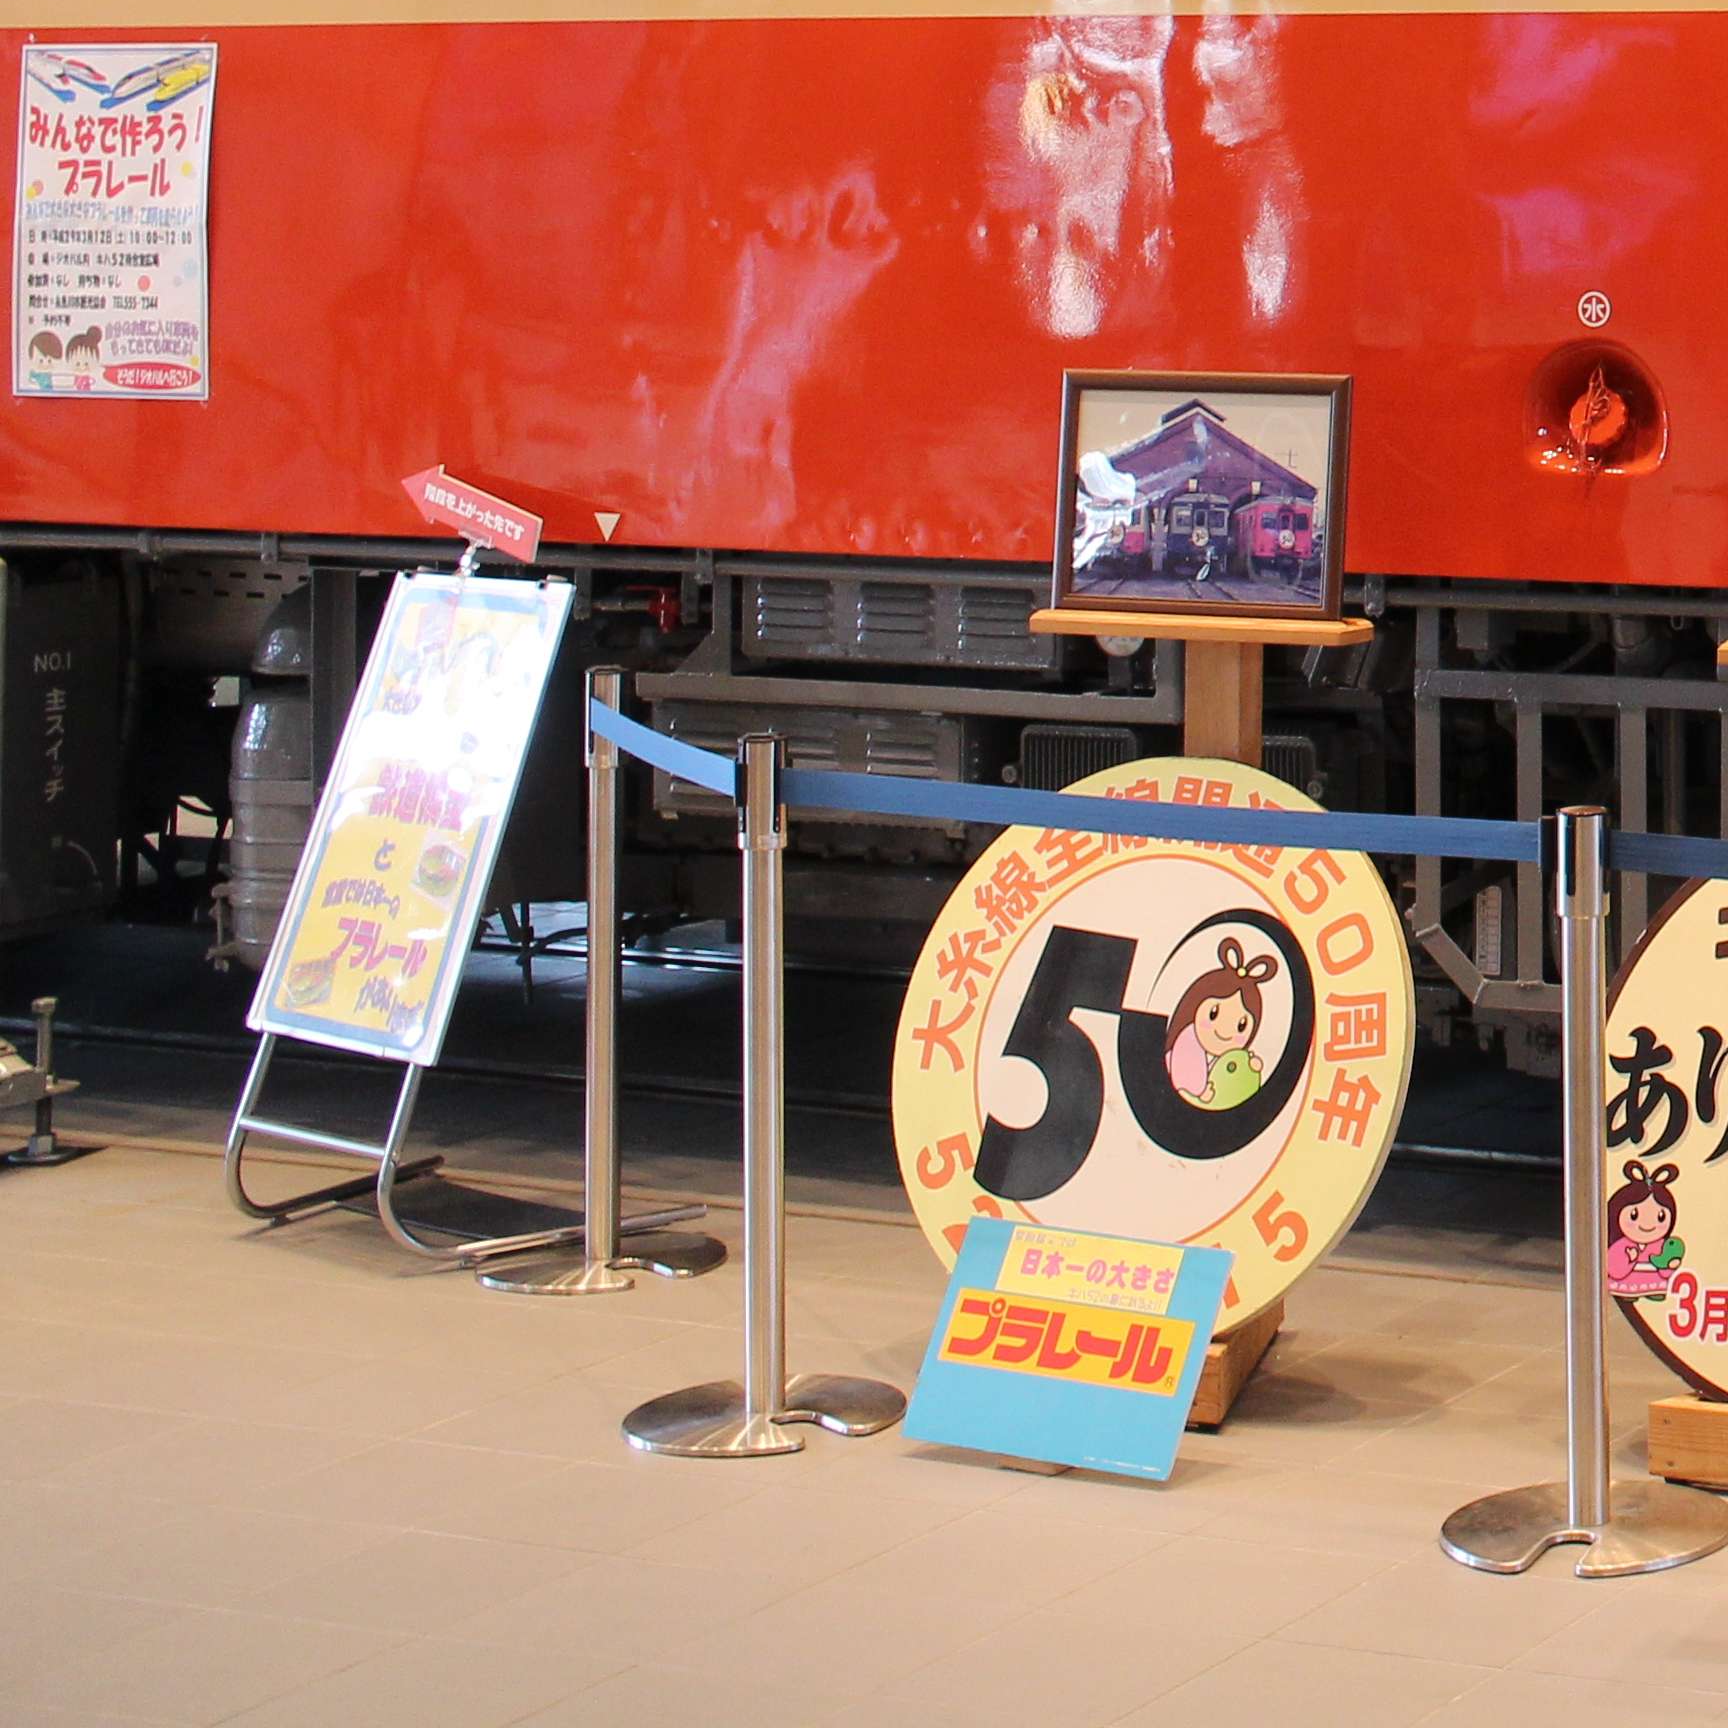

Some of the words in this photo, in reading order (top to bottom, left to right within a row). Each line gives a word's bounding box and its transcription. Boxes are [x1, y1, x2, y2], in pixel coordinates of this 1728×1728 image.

[57, 158, 171, 199] プラレール
[973, 908, 1317, 1203] 50
[1019, 1247, 1176, 1295] 日本一の大きさ
[947, 1297, 1174, 1385] プラレール
